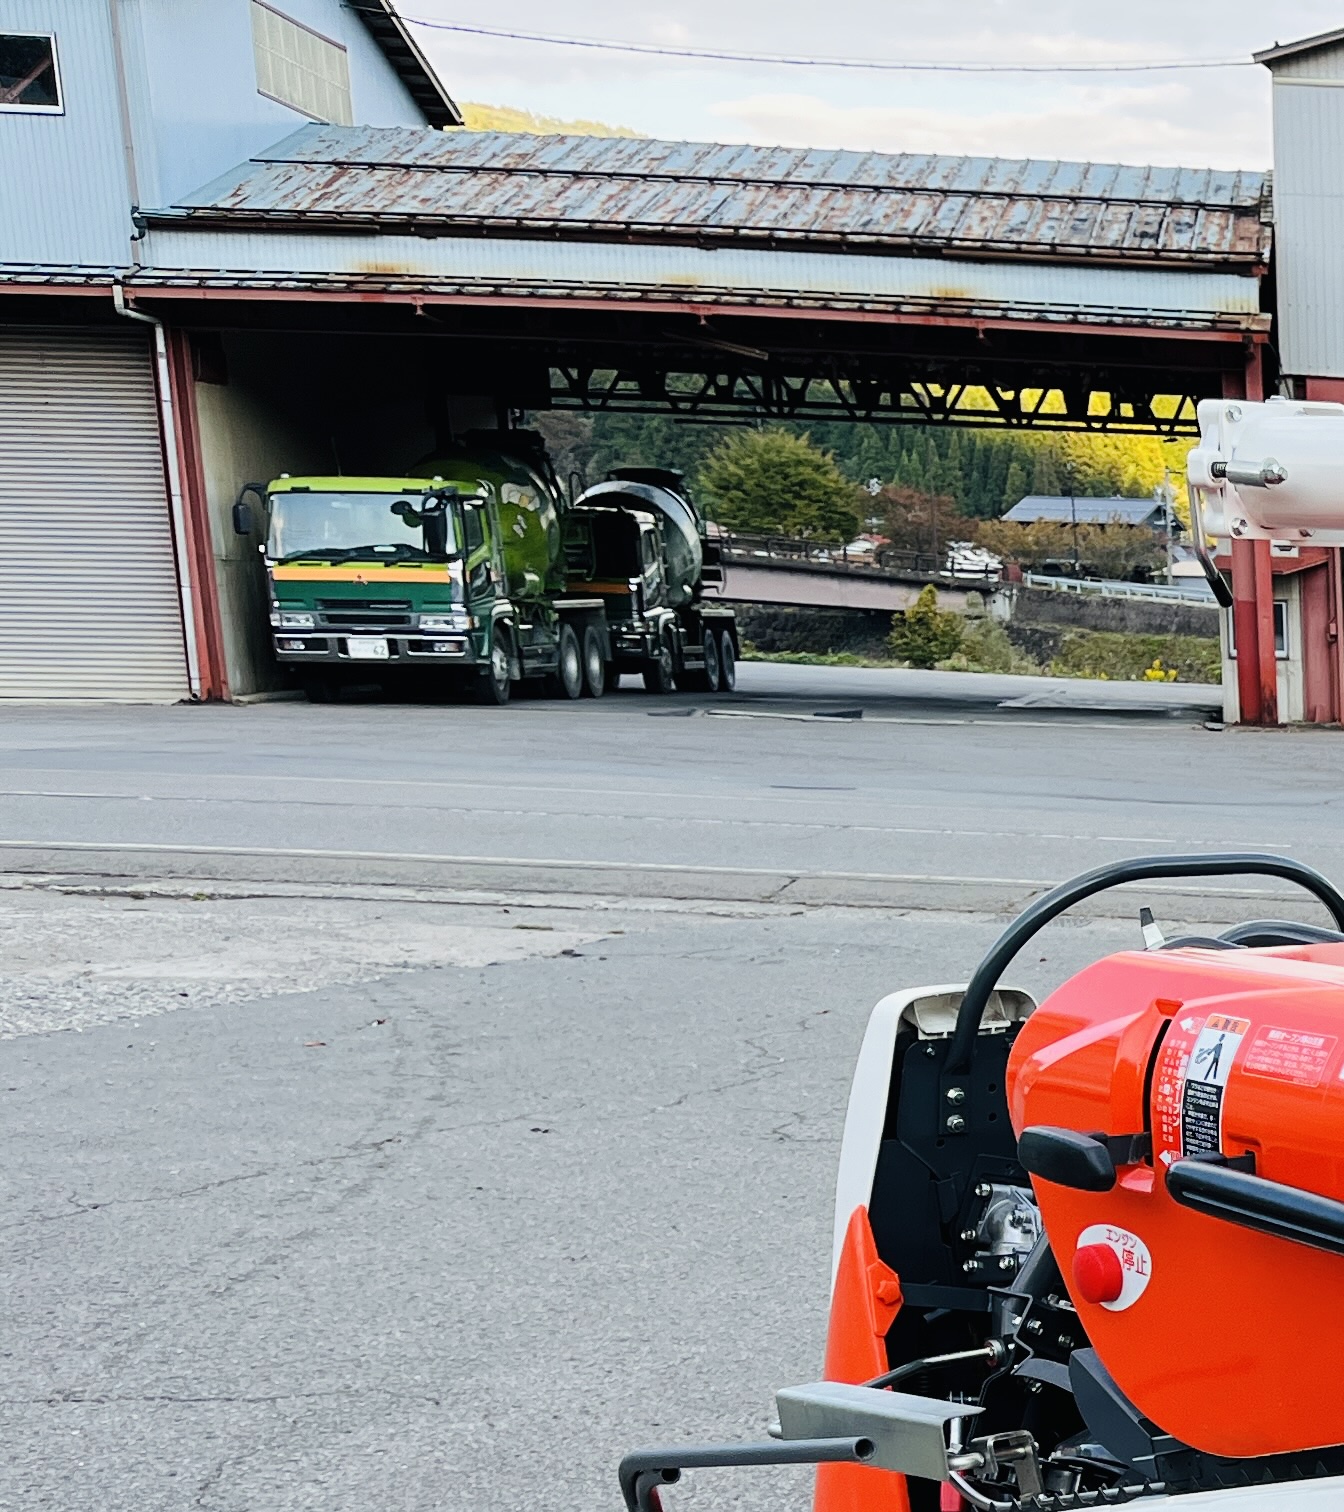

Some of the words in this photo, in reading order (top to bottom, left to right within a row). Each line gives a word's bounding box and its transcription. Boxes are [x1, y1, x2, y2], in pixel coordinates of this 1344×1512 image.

[1106, 1228, 1137, 1248] エンジン
[1122, 1248, 1149, 1276] 停止
